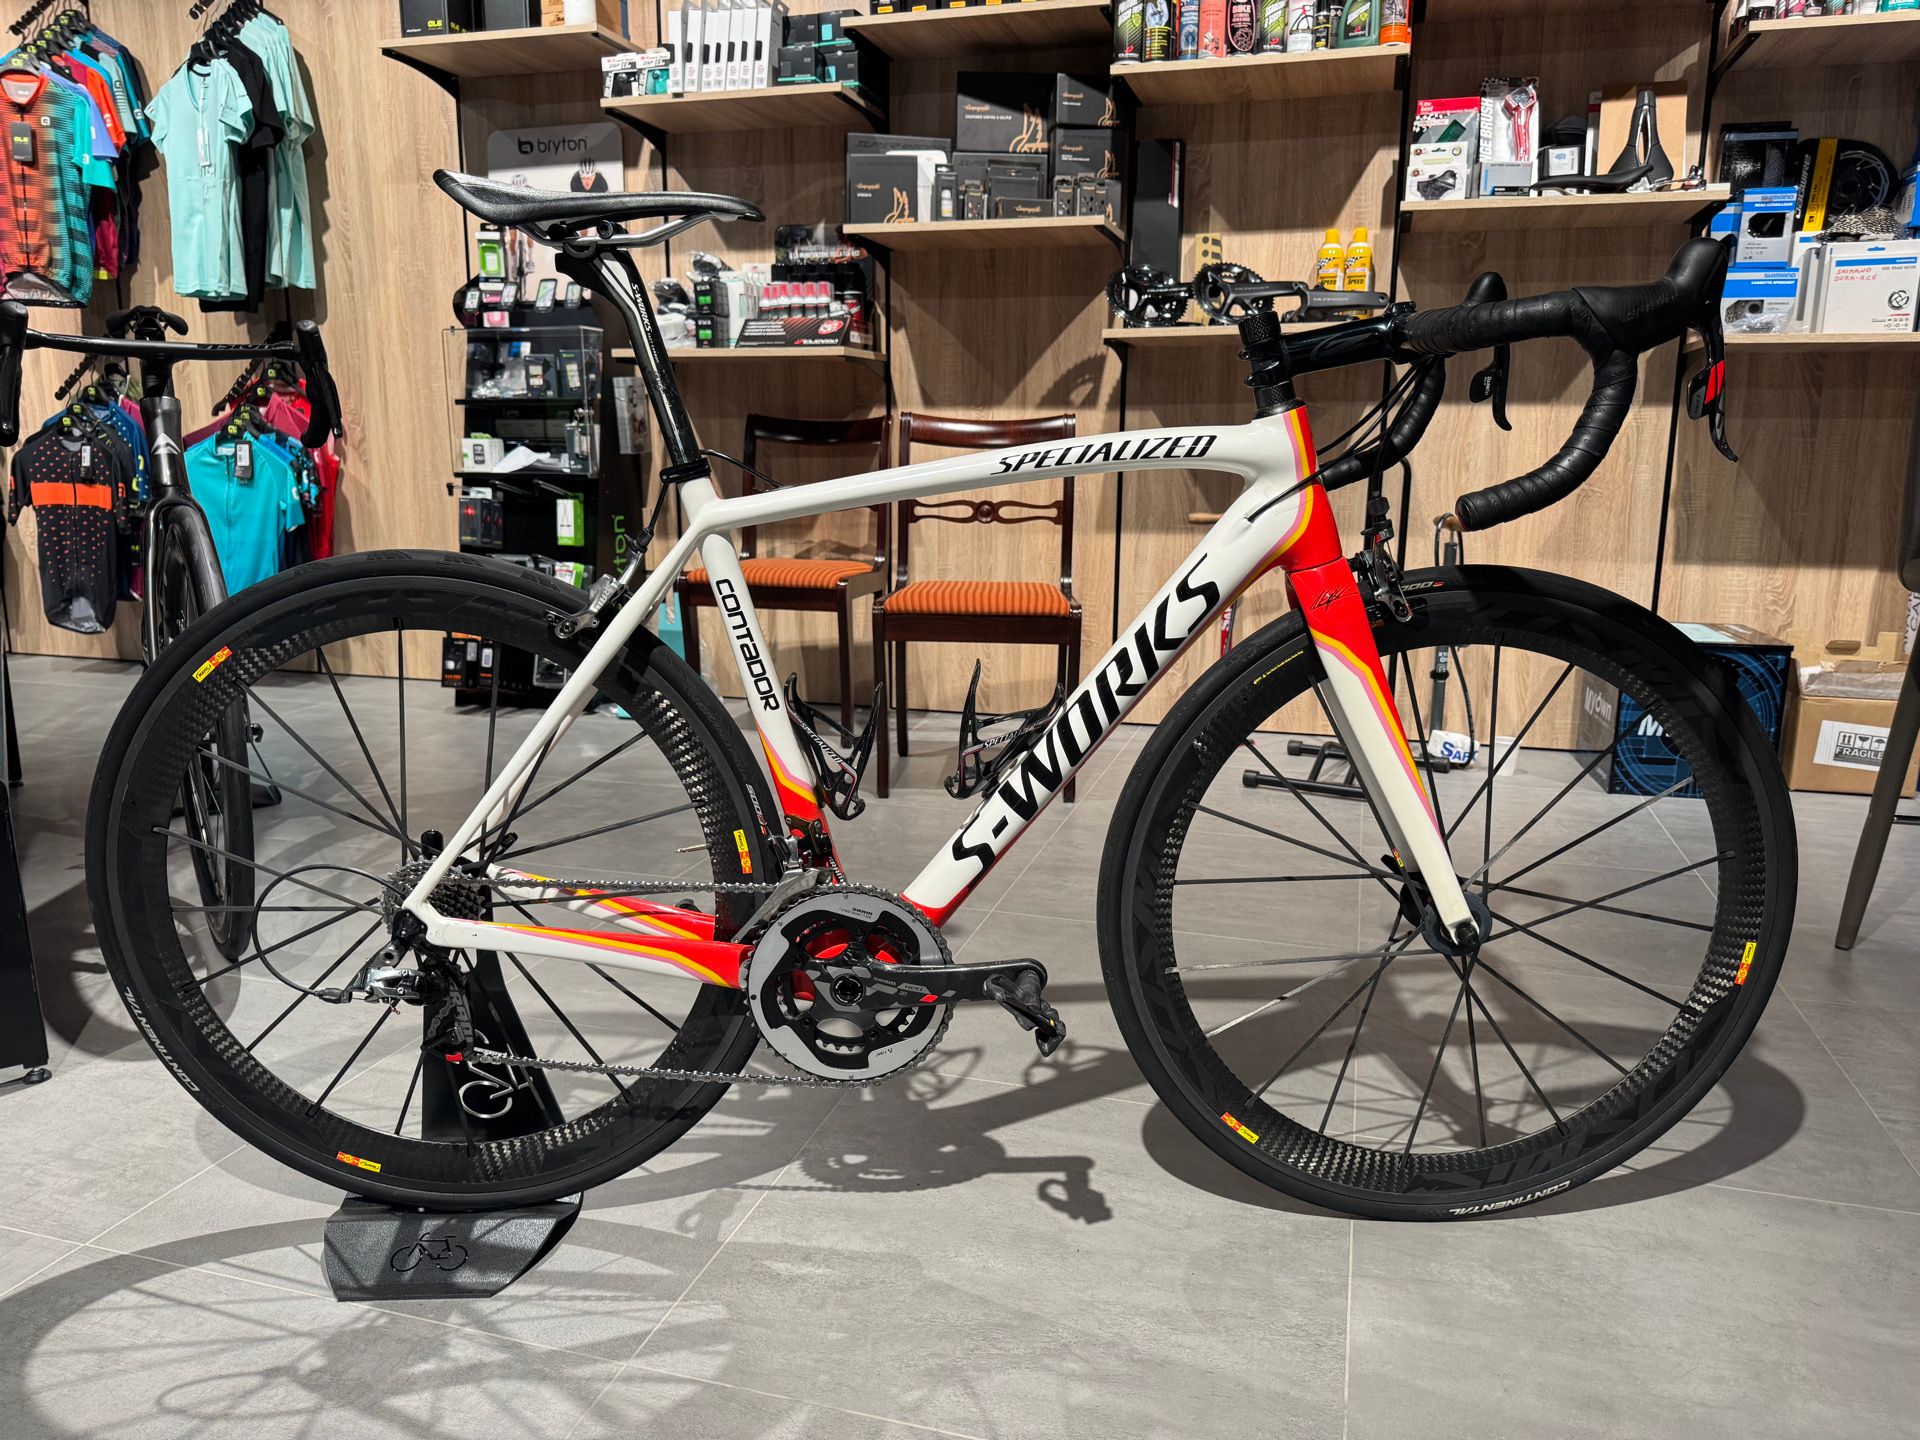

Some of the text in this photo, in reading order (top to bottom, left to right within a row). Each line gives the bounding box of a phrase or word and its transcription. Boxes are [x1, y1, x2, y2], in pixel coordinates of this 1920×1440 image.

[537, 136, 588, 155] bryton
[1478, 97, 1495, 163] NGE BRUSH
[631, 282, 653, 333] S-WORKS
[991, 435, 1218, 476] SPECIALIZED
[613, 514, 628, 575] ton
[715, 578, 780, 712] CONTADOR
[952, 552, 1221, 891] S-WORKS
[1637, 714, 1673, 737] M
[1835, 746, 1884, 761] FRAGILE
[852, 907, 873, 916] SRAM
[123, 986, 201, 1092] CONTINENTAL
[1449, 1180, 1571, 1216] CONTINENTAL
